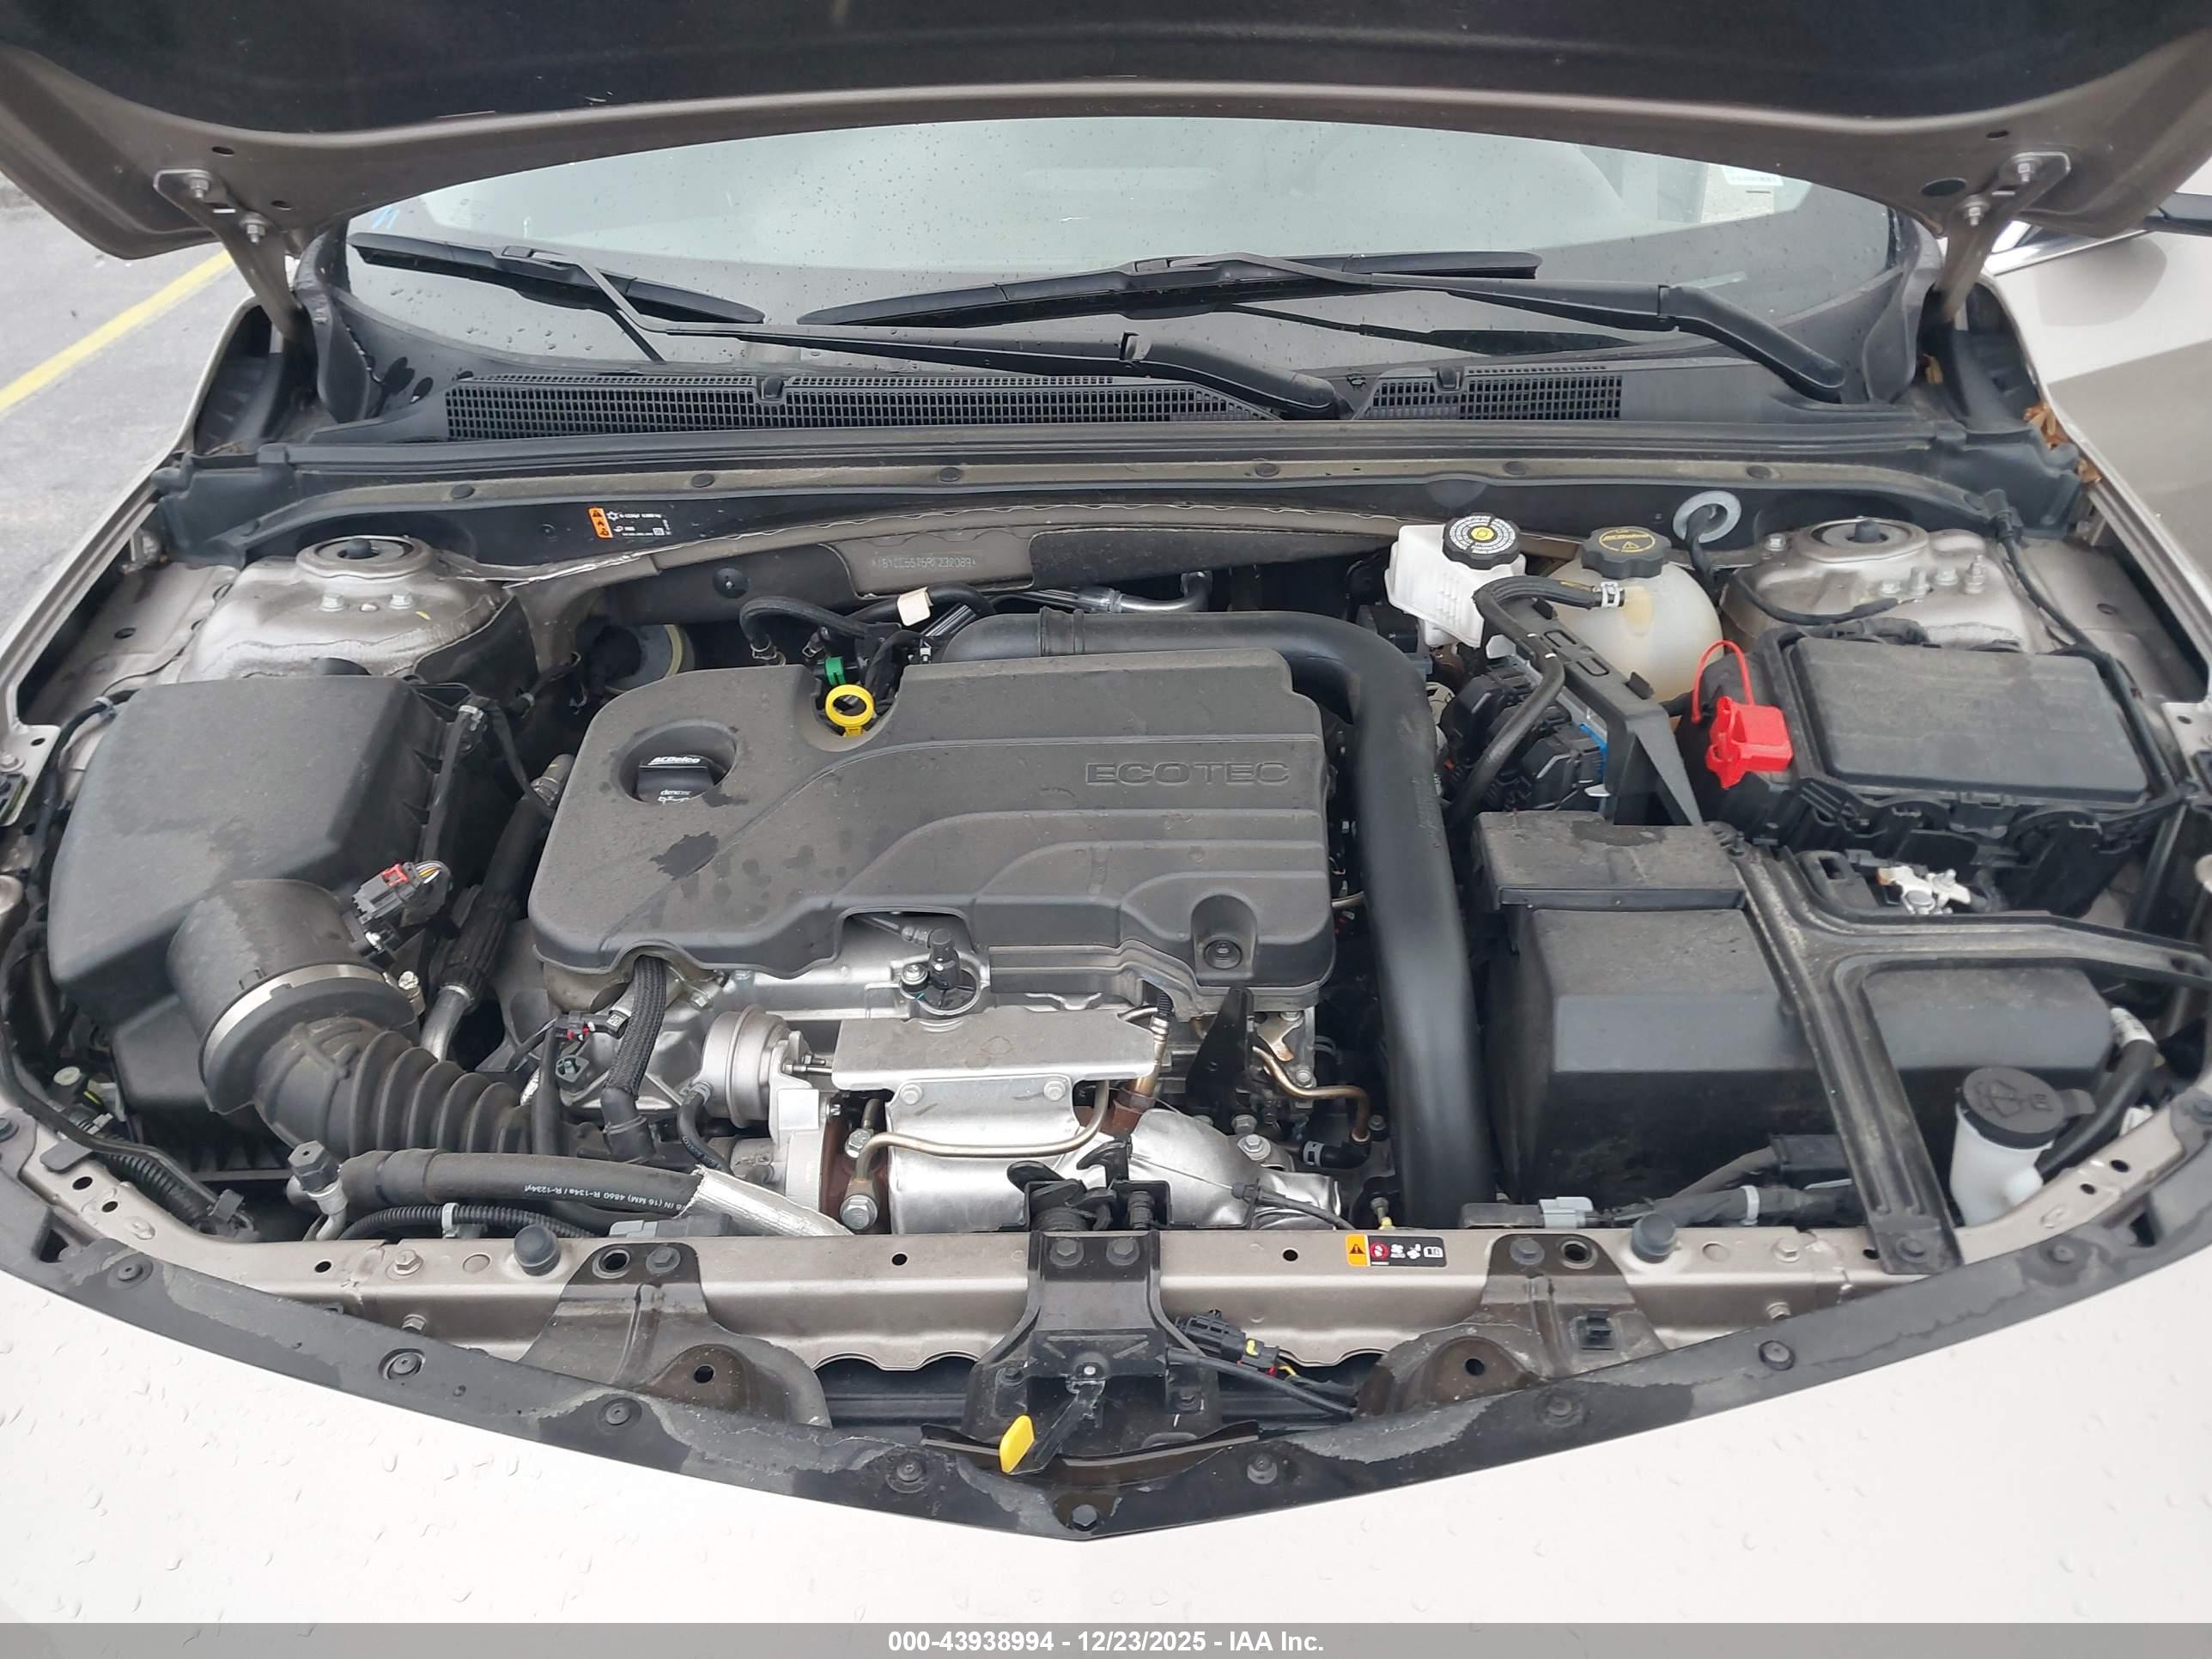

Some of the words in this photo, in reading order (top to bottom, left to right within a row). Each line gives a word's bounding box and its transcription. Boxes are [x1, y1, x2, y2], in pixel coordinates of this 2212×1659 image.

[1085, 762, 1290, 786] ECOTEC
[568, 1188, 600, 1199] R-134a
[627, 1194, 647, 1205] MM)
